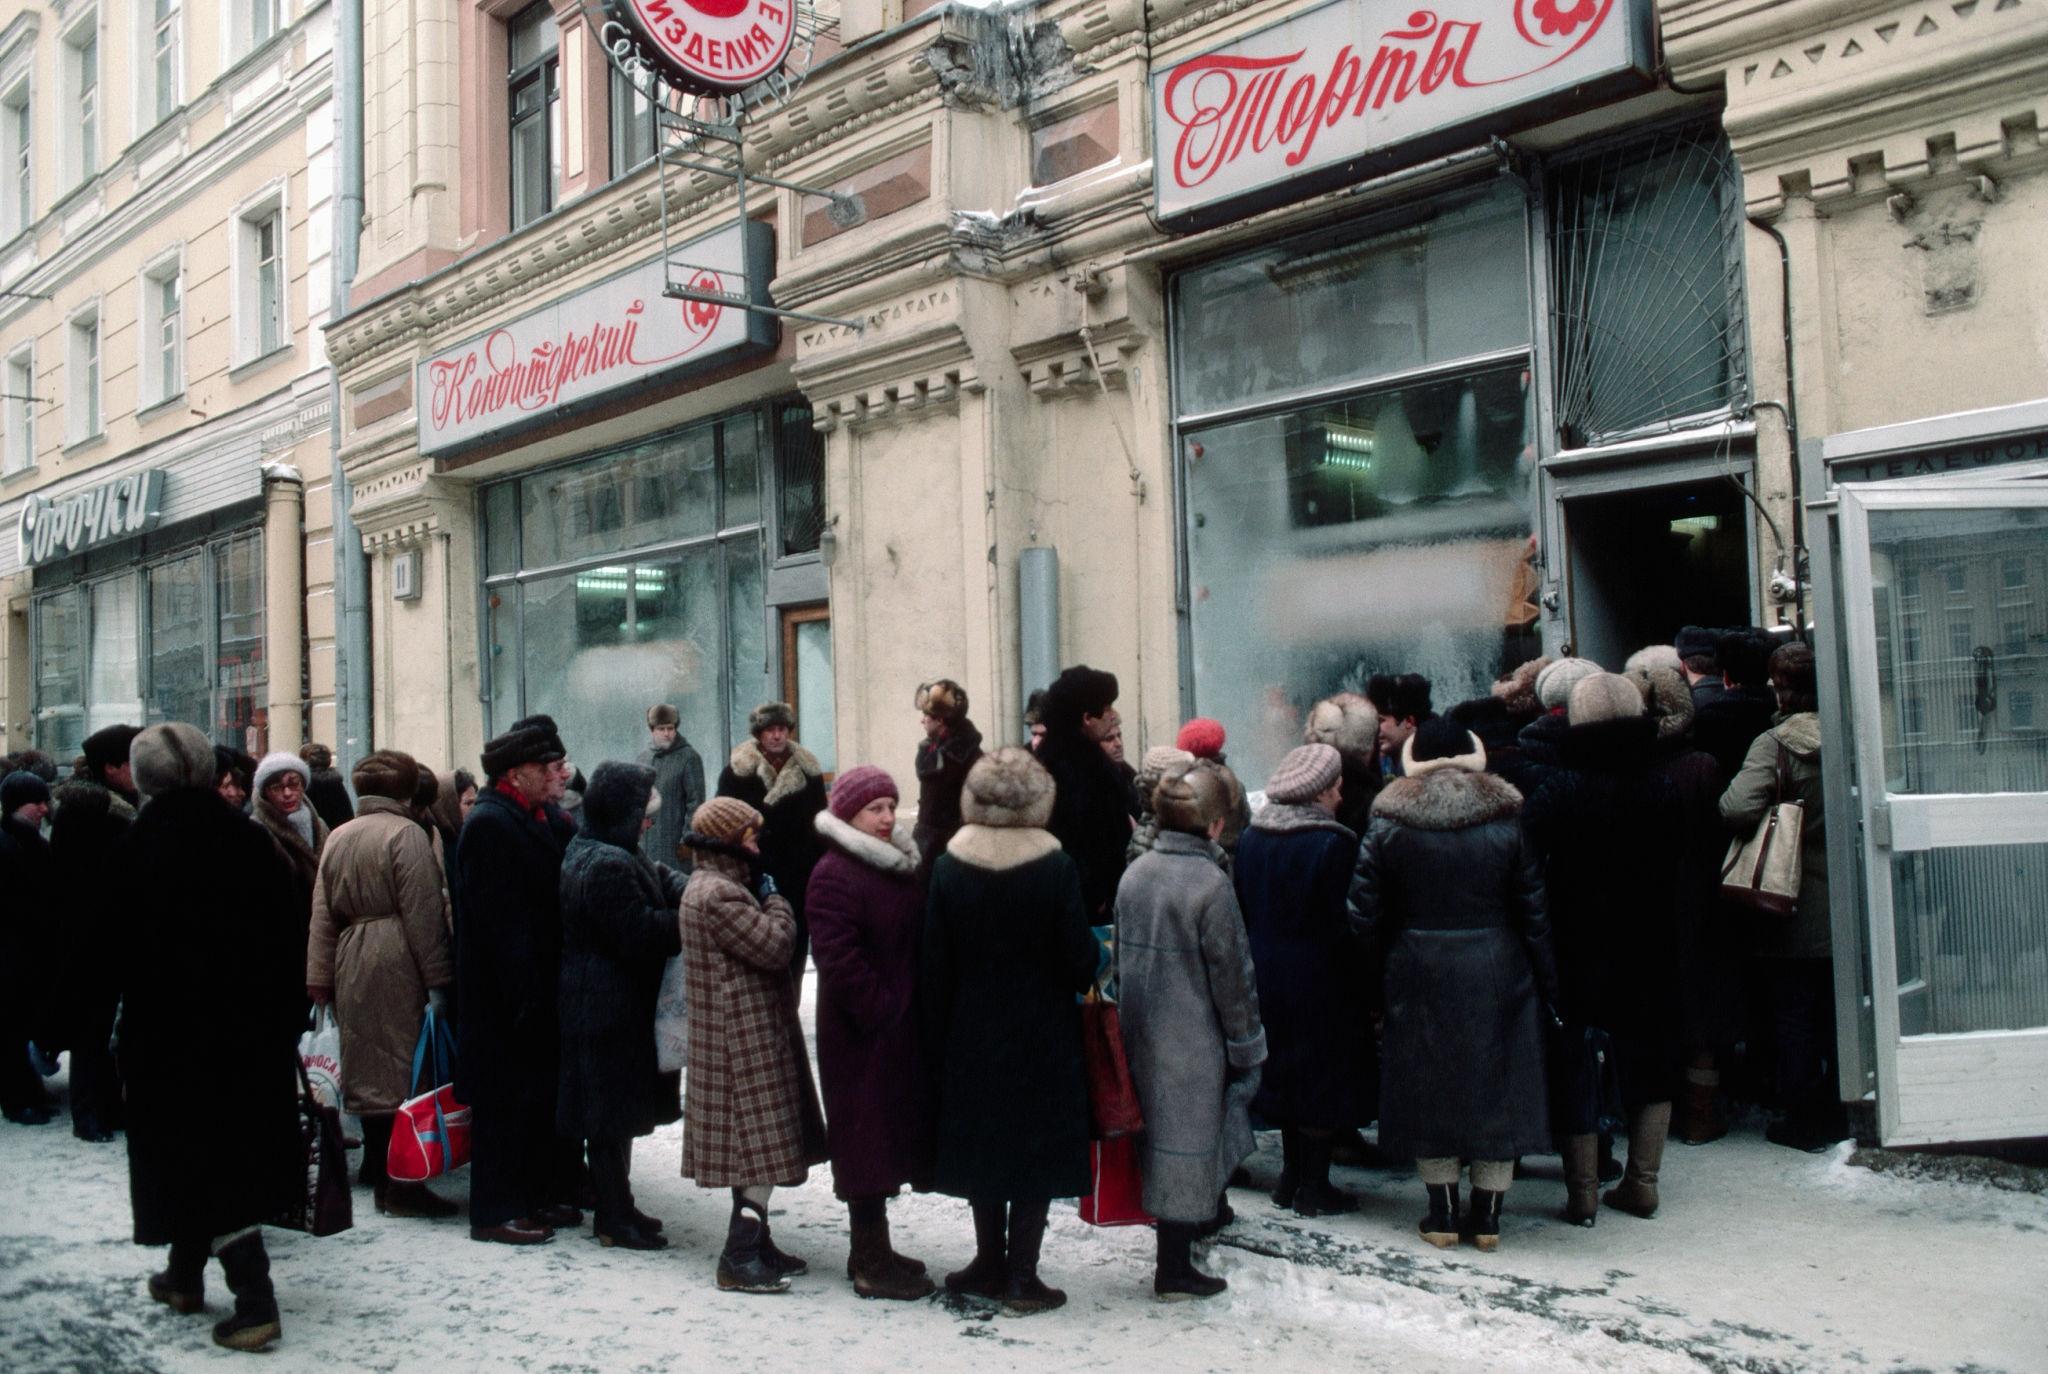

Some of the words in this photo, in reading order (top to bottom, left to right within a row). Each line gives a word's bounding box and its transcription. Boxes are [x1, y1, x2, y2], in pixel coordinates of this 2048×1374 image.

[646, 0, 775, 70] ИЗДЕЛИЯ
[1164, 11, 1482, 189] Торты
[430, 299, 645, 432] Кондитерский
[18, 471, 153, 567] Сорочки
